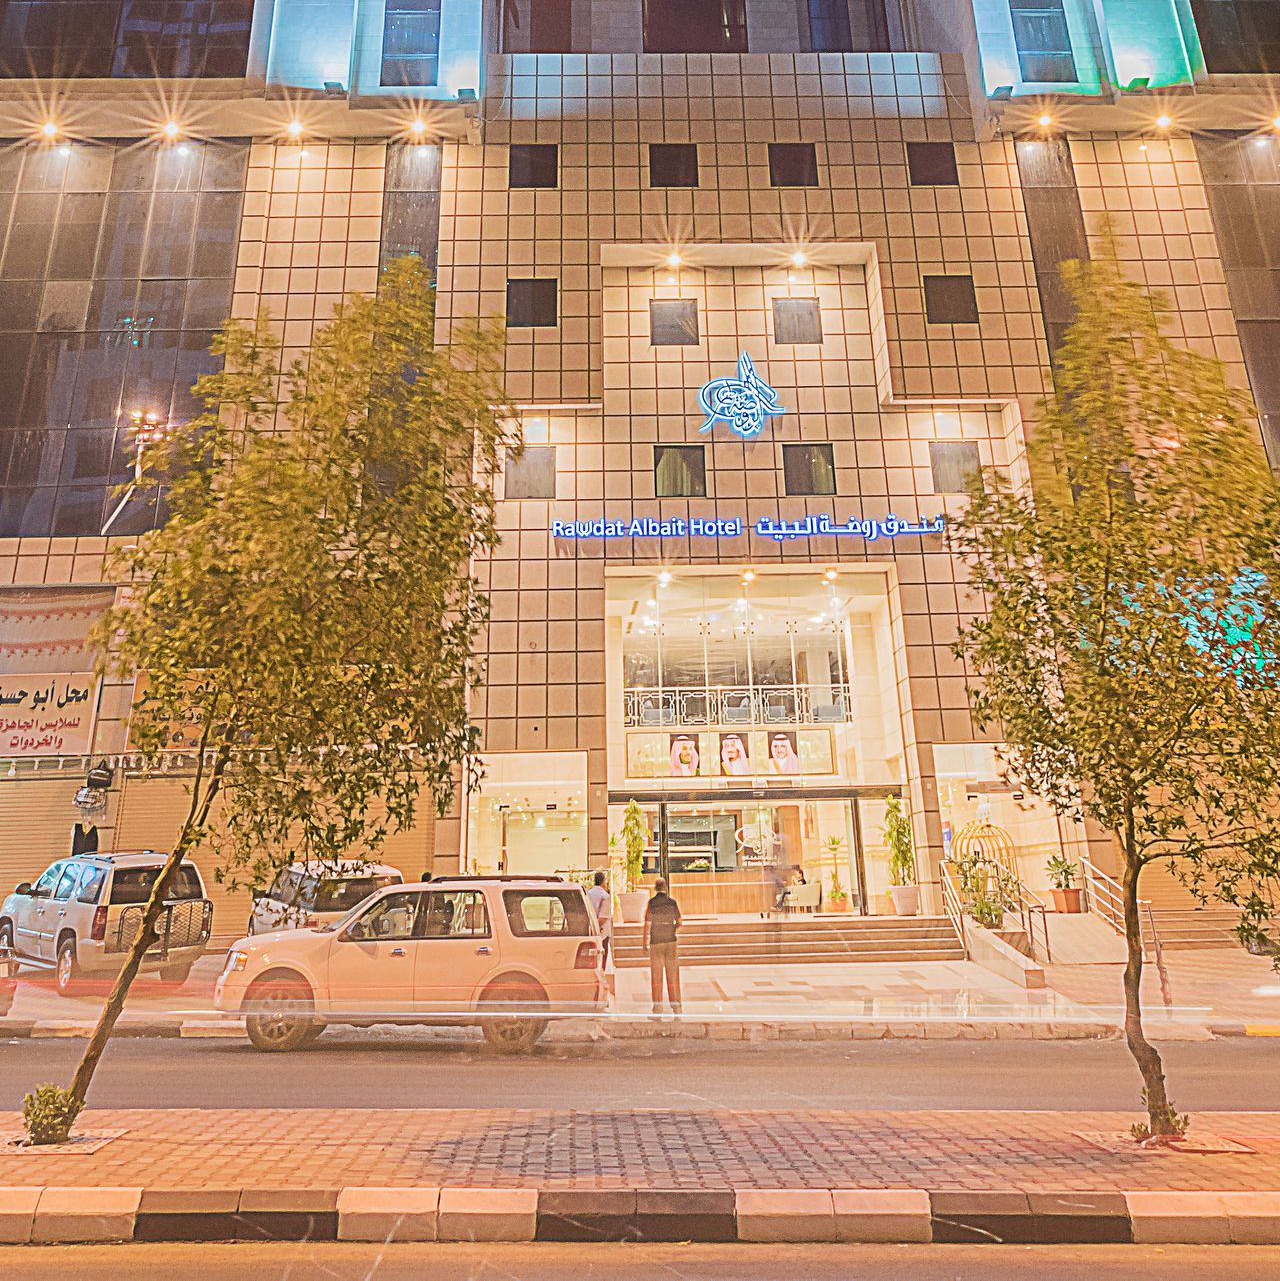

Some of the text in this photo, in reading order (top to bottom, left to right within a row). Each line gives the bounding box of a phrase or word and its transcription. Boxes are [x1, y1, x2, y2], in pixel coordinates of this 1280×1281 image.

[628, 517, 685, 536] Albait
[690, 517, 742, 536] Hotel
[756, 513, 945, 541] فندق روضة البيت
[29, 679, 56, 712] أبو
[57, 682, 89, 710] محل
[39, 717, 81, 733] للملابس
[9, 734, 64, 750] والخردوات
